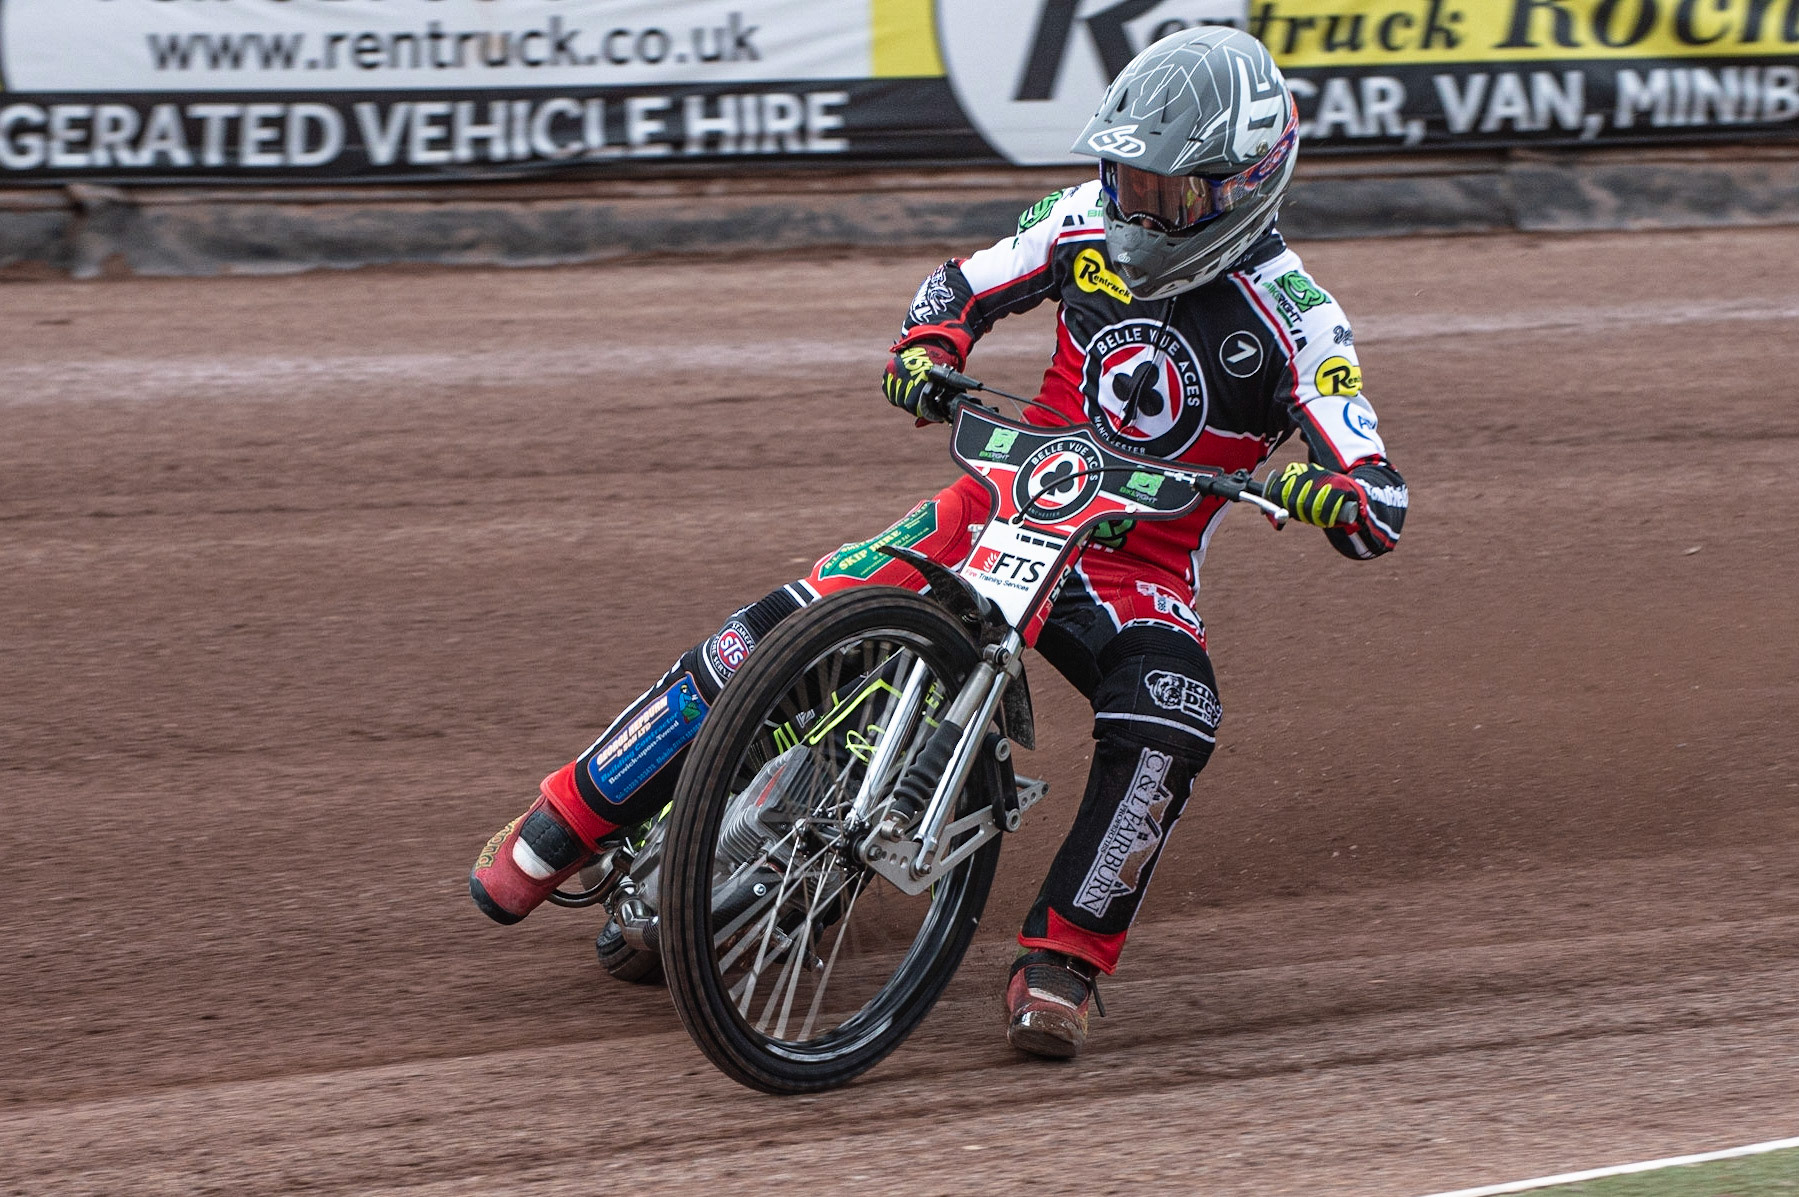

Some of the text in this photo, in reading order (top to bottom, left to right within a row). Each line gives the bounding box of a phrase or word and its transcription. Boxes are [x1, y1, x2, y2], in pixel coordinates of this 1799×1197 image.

[147, 12, 760, 71] www.rentruck.co.uk
[1433, 70, 1604, 142] VAN,
[1613, 65, 1799, 129] MINIB
[0, 91, 850, 170] GERATED VEHICLE HIRE
[1079, 256, 1130, 298] Rentruck
[1096, 327, 1201, 408] BELLE VUE ACES
[1031, 442, 1099, 481] BELLE VUE ACS
[839, 550, 868, 570] SKIP
[965, 569, 1029, 592] Fire Training Services
[992, 553, 1046, 583] FTS
[721, 635, 744, 666] STS
[637, 722, 652, 738] LTD
[1185, 693, 1218, 726] DICK
[601, 750, 635, 782] Building
[634, 712, 678, 751] Contractor
[608, 720, 680, 785] Berwick-upon-Tweed
[1082, 754, 1165, 914] C & L FAIRBURN
[1101, 803, 1128, 853] PROPERTIES
